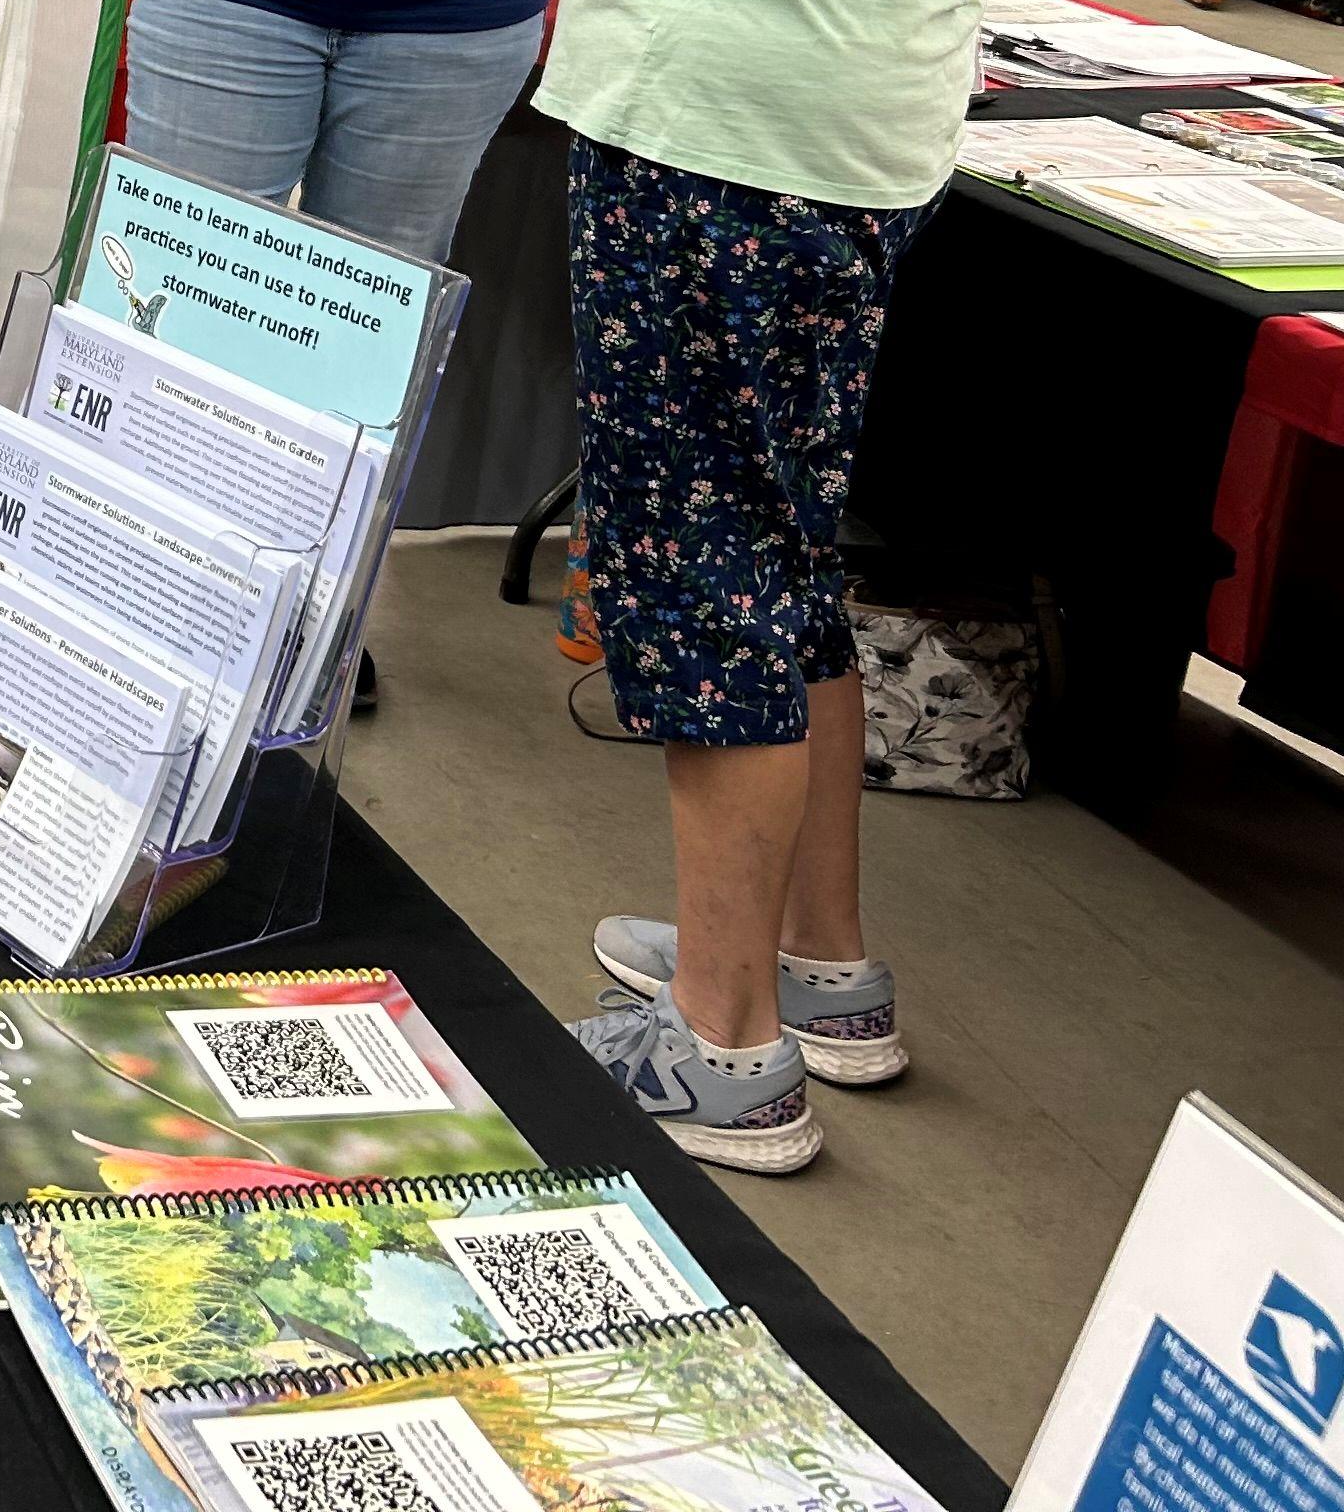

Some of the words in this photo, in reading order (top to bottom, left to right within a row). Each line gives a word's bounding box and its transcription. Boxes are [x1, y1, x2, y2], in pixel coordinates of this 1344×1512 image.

[112, 172, 152, 202] Take
[151, 190, 184, 214] one
[183, 200, 206, 223] to
[204, 207, 252, 241] learn
[250, 224, 306, 262] about
[303, 244, 416, 307] landscaping
[121, 215, 198, 262] practices
[192, 246, 230, 276] you
[228, 261, 263, 287] can
[261, 274, 296, 299] use
[294, 284, 319, 309] to
[317, 293, 385, 335] reduce
[62, 334, 126, 373] MARYLAND
[157, 270, 259, 326] stormwater
[255, 309, 323, 352] runoff!
[58, 347, 123, 384] EXTENSION
[67, 383, 118, 433] ENR
[152, 376, 212, 415] Stormwater
[209, 403, 258, 437] Solutions
[262, 430, 288, 452] Rain
[286, 442, 327, 470] Garden
[45, 474, 103, 515] Stormwater
[99, 503, 147, 539] Solutions
[149, 529, 206, 570] Landscape
[6, 608, 55, 646] Solutions
[55, 637, 111, 681] Permeable
[105, 669, 168, 715] Hardscapes
